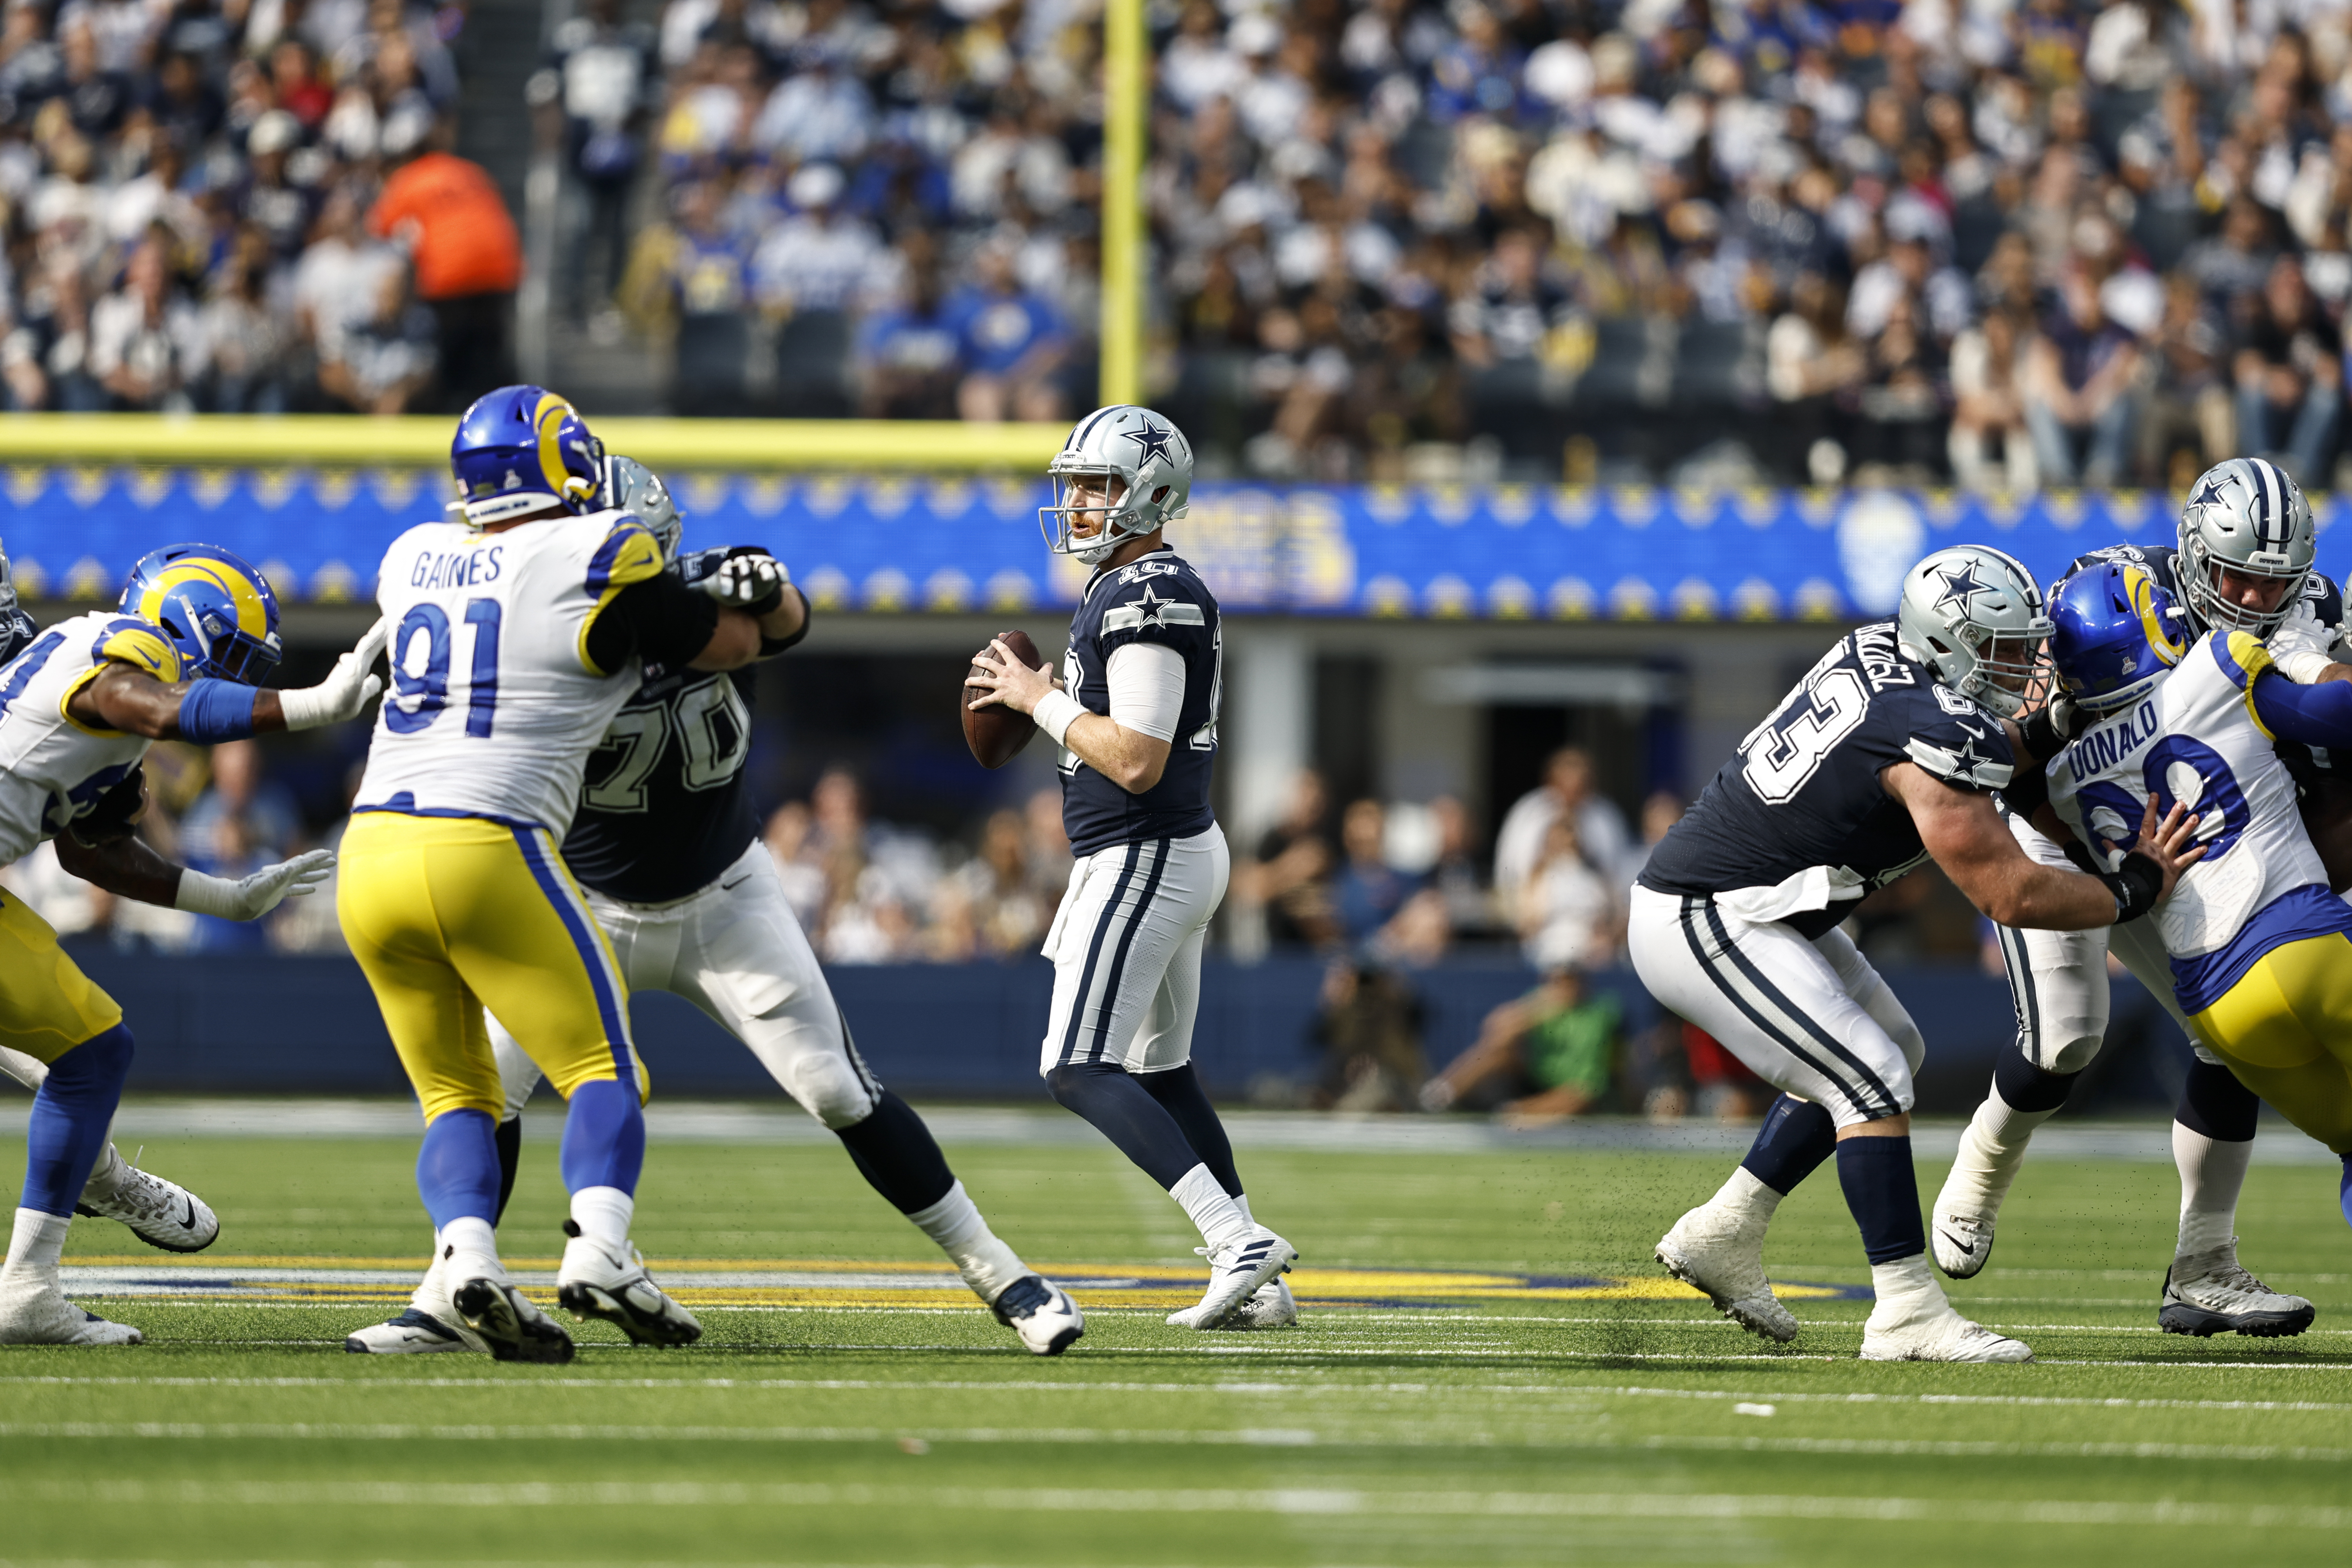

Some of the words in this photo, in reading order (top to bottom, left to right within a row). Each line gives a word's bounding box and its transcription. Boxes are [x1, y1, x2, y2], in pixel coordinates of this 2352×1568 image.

[411, 546, 503, 590] GAINES
[1118, 561, 1178, 585] 10
[385, 597, 501, 738] 91
[582, 673, 751, 813] 70
[2068, 700, 2157, 783] DONALD
[2075, 733, 2250, 862] 99
